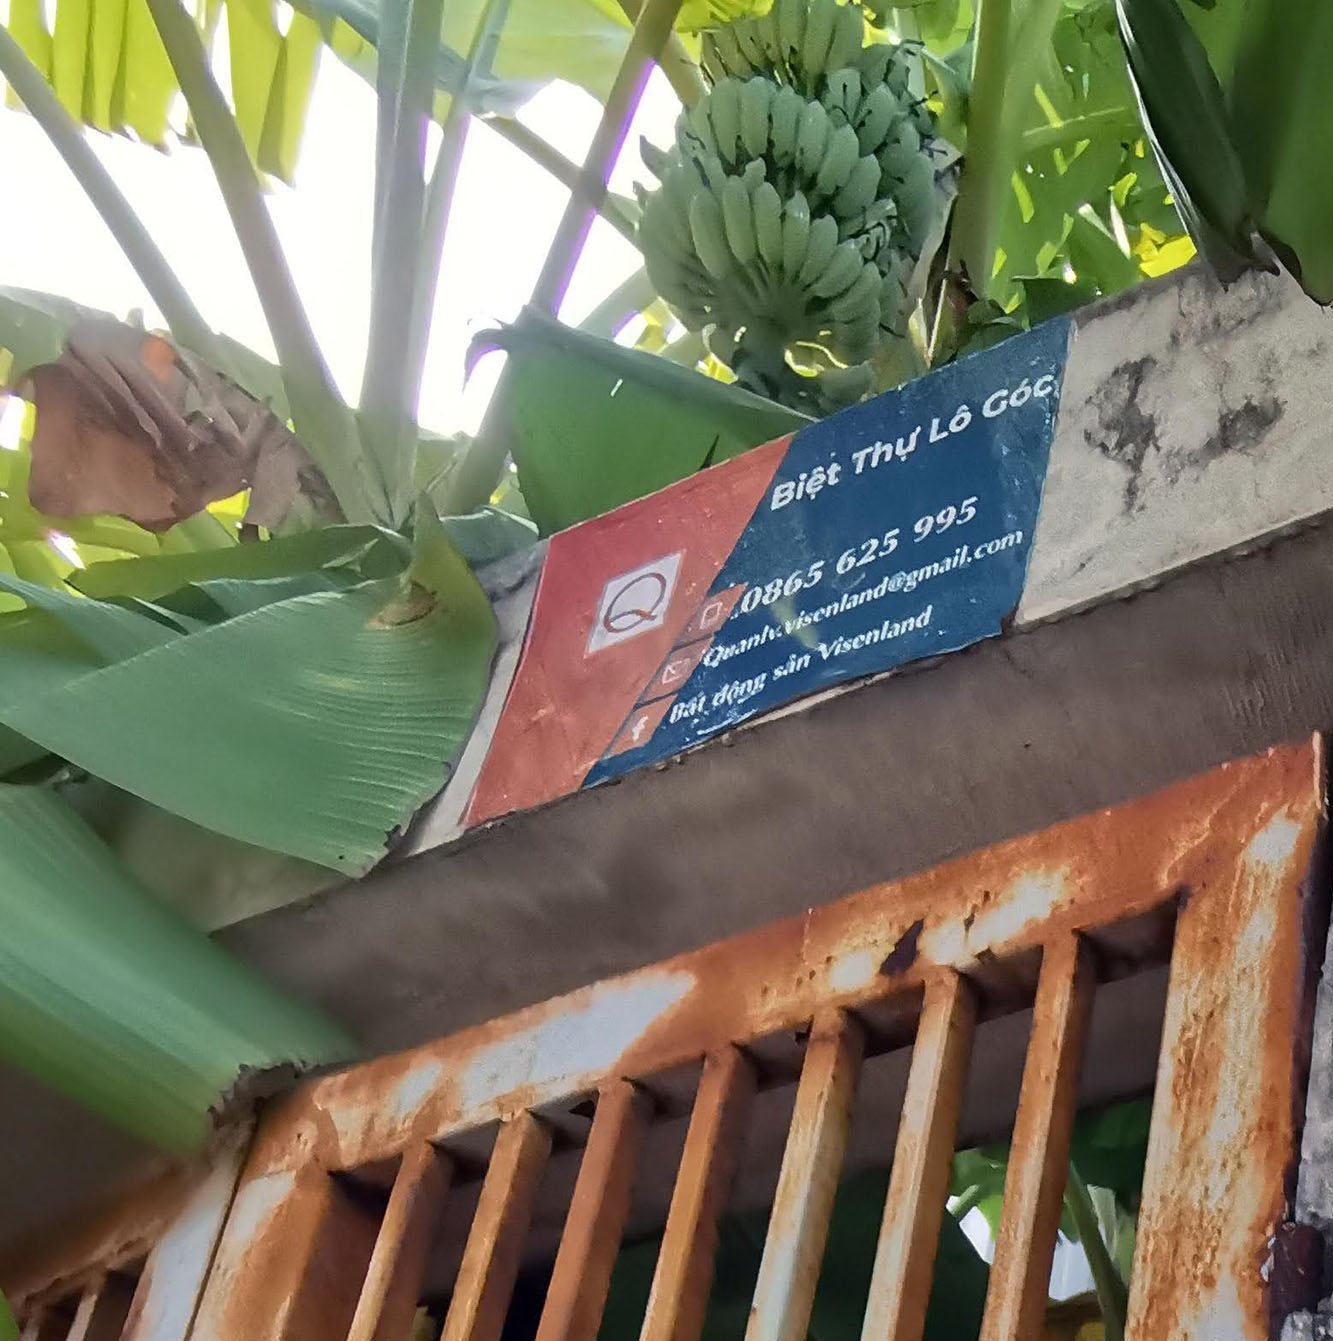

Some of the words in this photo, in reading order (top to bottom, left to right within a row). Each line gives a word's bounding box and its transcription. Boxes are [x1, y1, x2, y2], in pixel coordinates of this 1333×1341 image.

[770, 463, 842, 511] Biệt
[852, 426, 922, 475] Thự
[929, 404, 972, 443] Lô
[982, 374, 1054, 418] Góc
[741, 560, 825, 614] 0865
[836, 528, 899, 575] 625
[914, 496, 979, 543] 995
[604, 572, 667, 633] Q
[815, 604, 933, 661] Visenland
